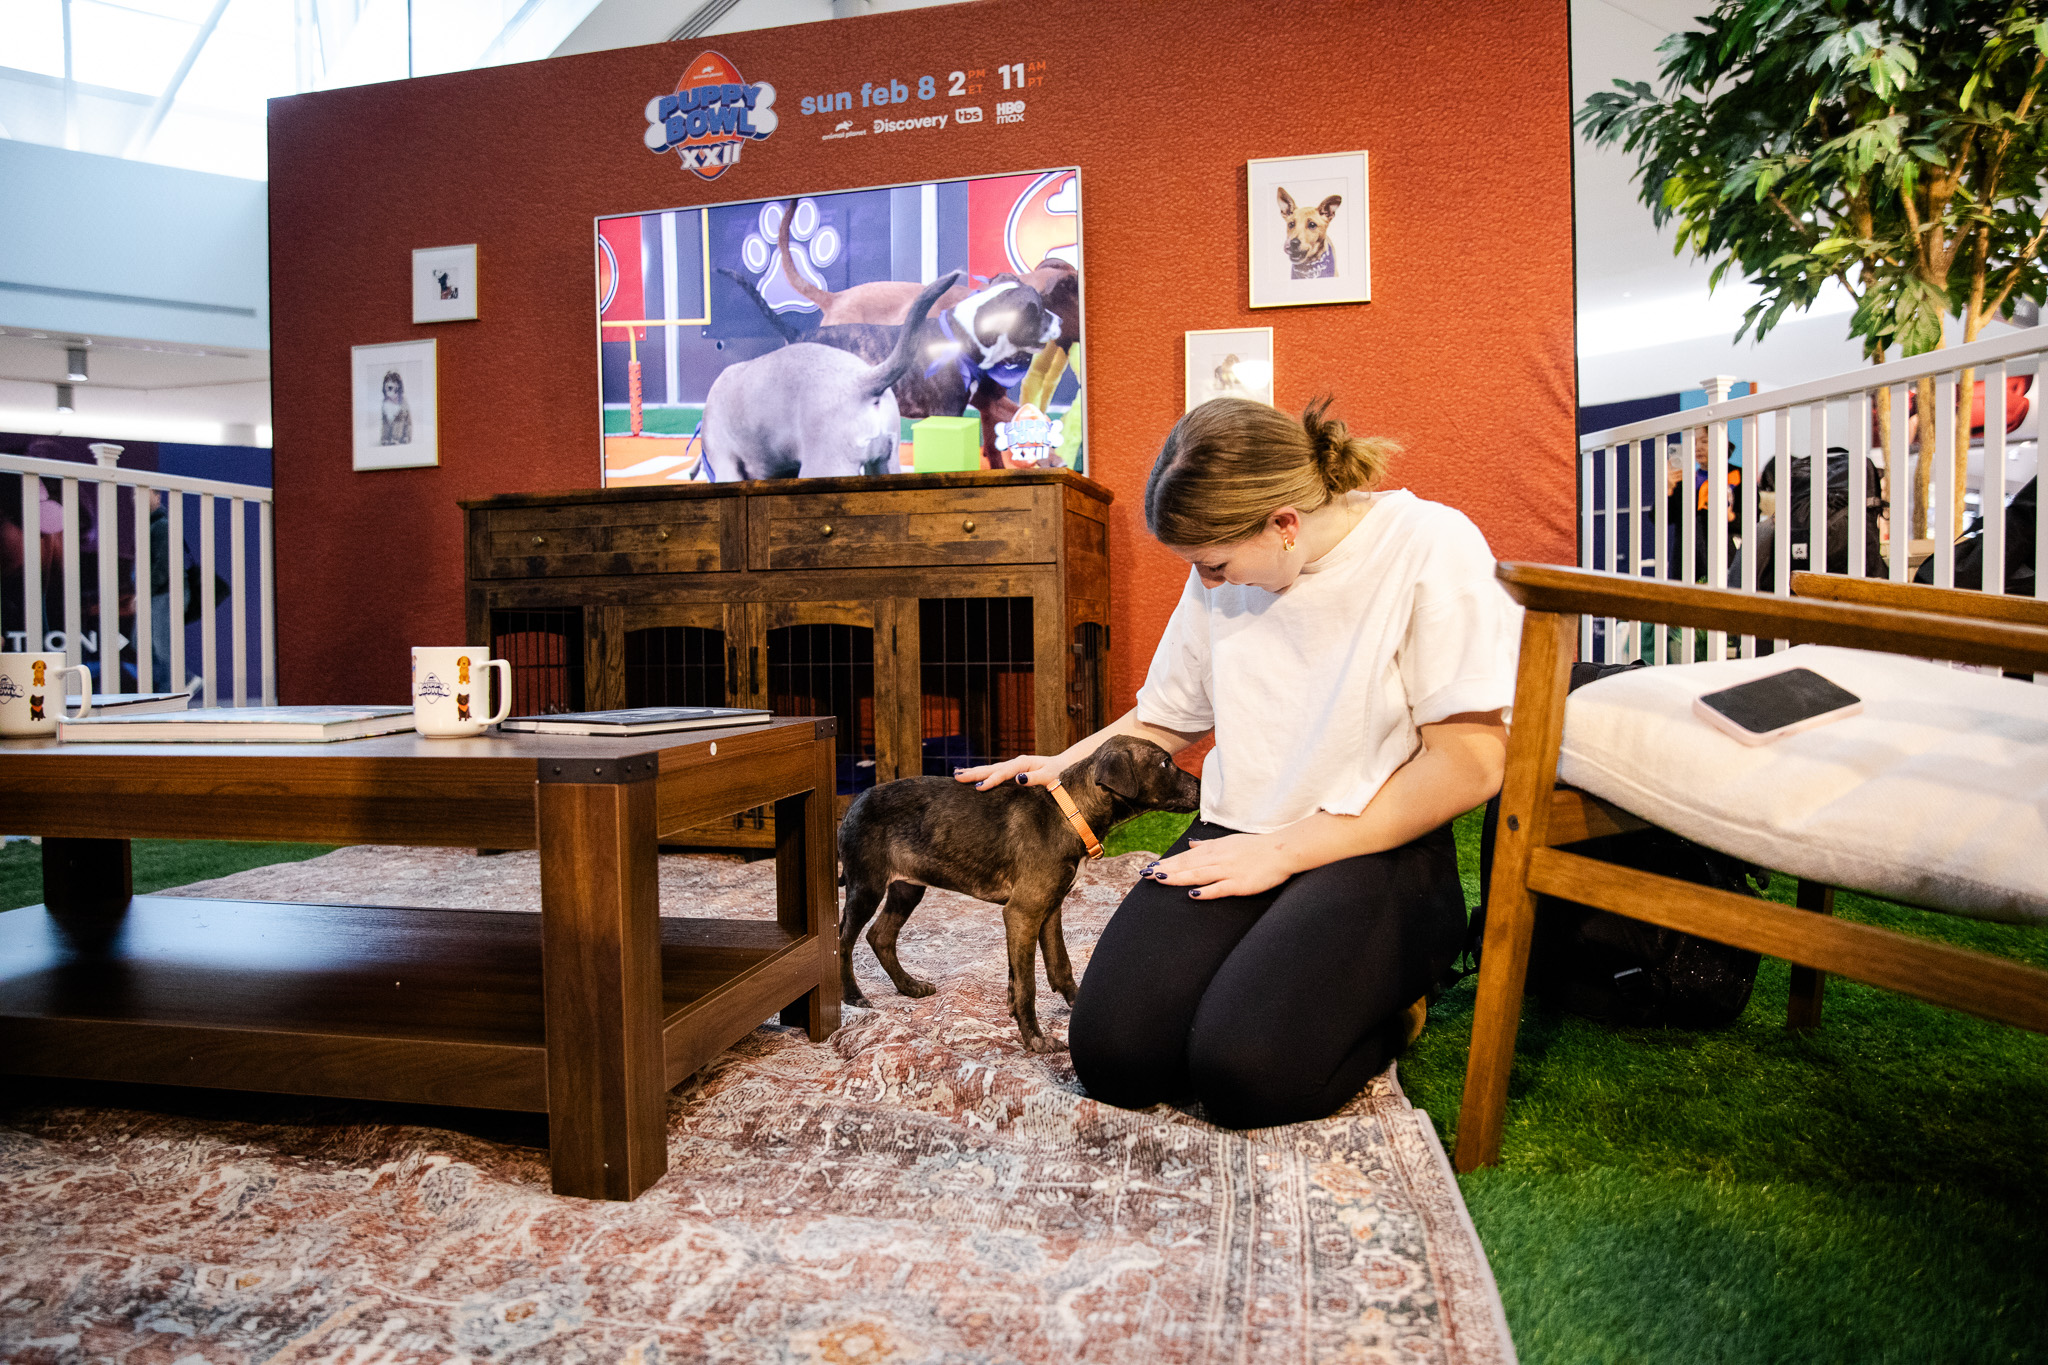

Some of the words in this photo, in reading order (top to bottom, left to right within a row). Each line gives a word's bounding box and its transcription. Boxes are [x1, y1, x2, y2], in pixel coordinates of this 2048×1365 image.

[948, 71, 966, 96] 2
[968, 68, 986, 79] PM
[998, 63, 1025, 90] 11
[1028, 60, 1046, 72] AM
[1028, 76, 1043, 87] PT
[801, 91, 852, 115] sun
[861, 78, 909, 107] feb
[917, 75, 936, 100] 8
[968, 84, 983, 94] ET
[659, 84, 762, 123] PUPPY
[996, 101, 1026, 115] HBO
[873, 114, 949, 134] Discovery
[957, 110, 981, 121] tbs
[996, 113, 1025, 124] max
[666, 107, 757, 145] BOWL
[681, 142, 741, 169] XXII
[1004, 419, 1054, 435] PUPPY
[1010, 446, 1050, 461] XXII
